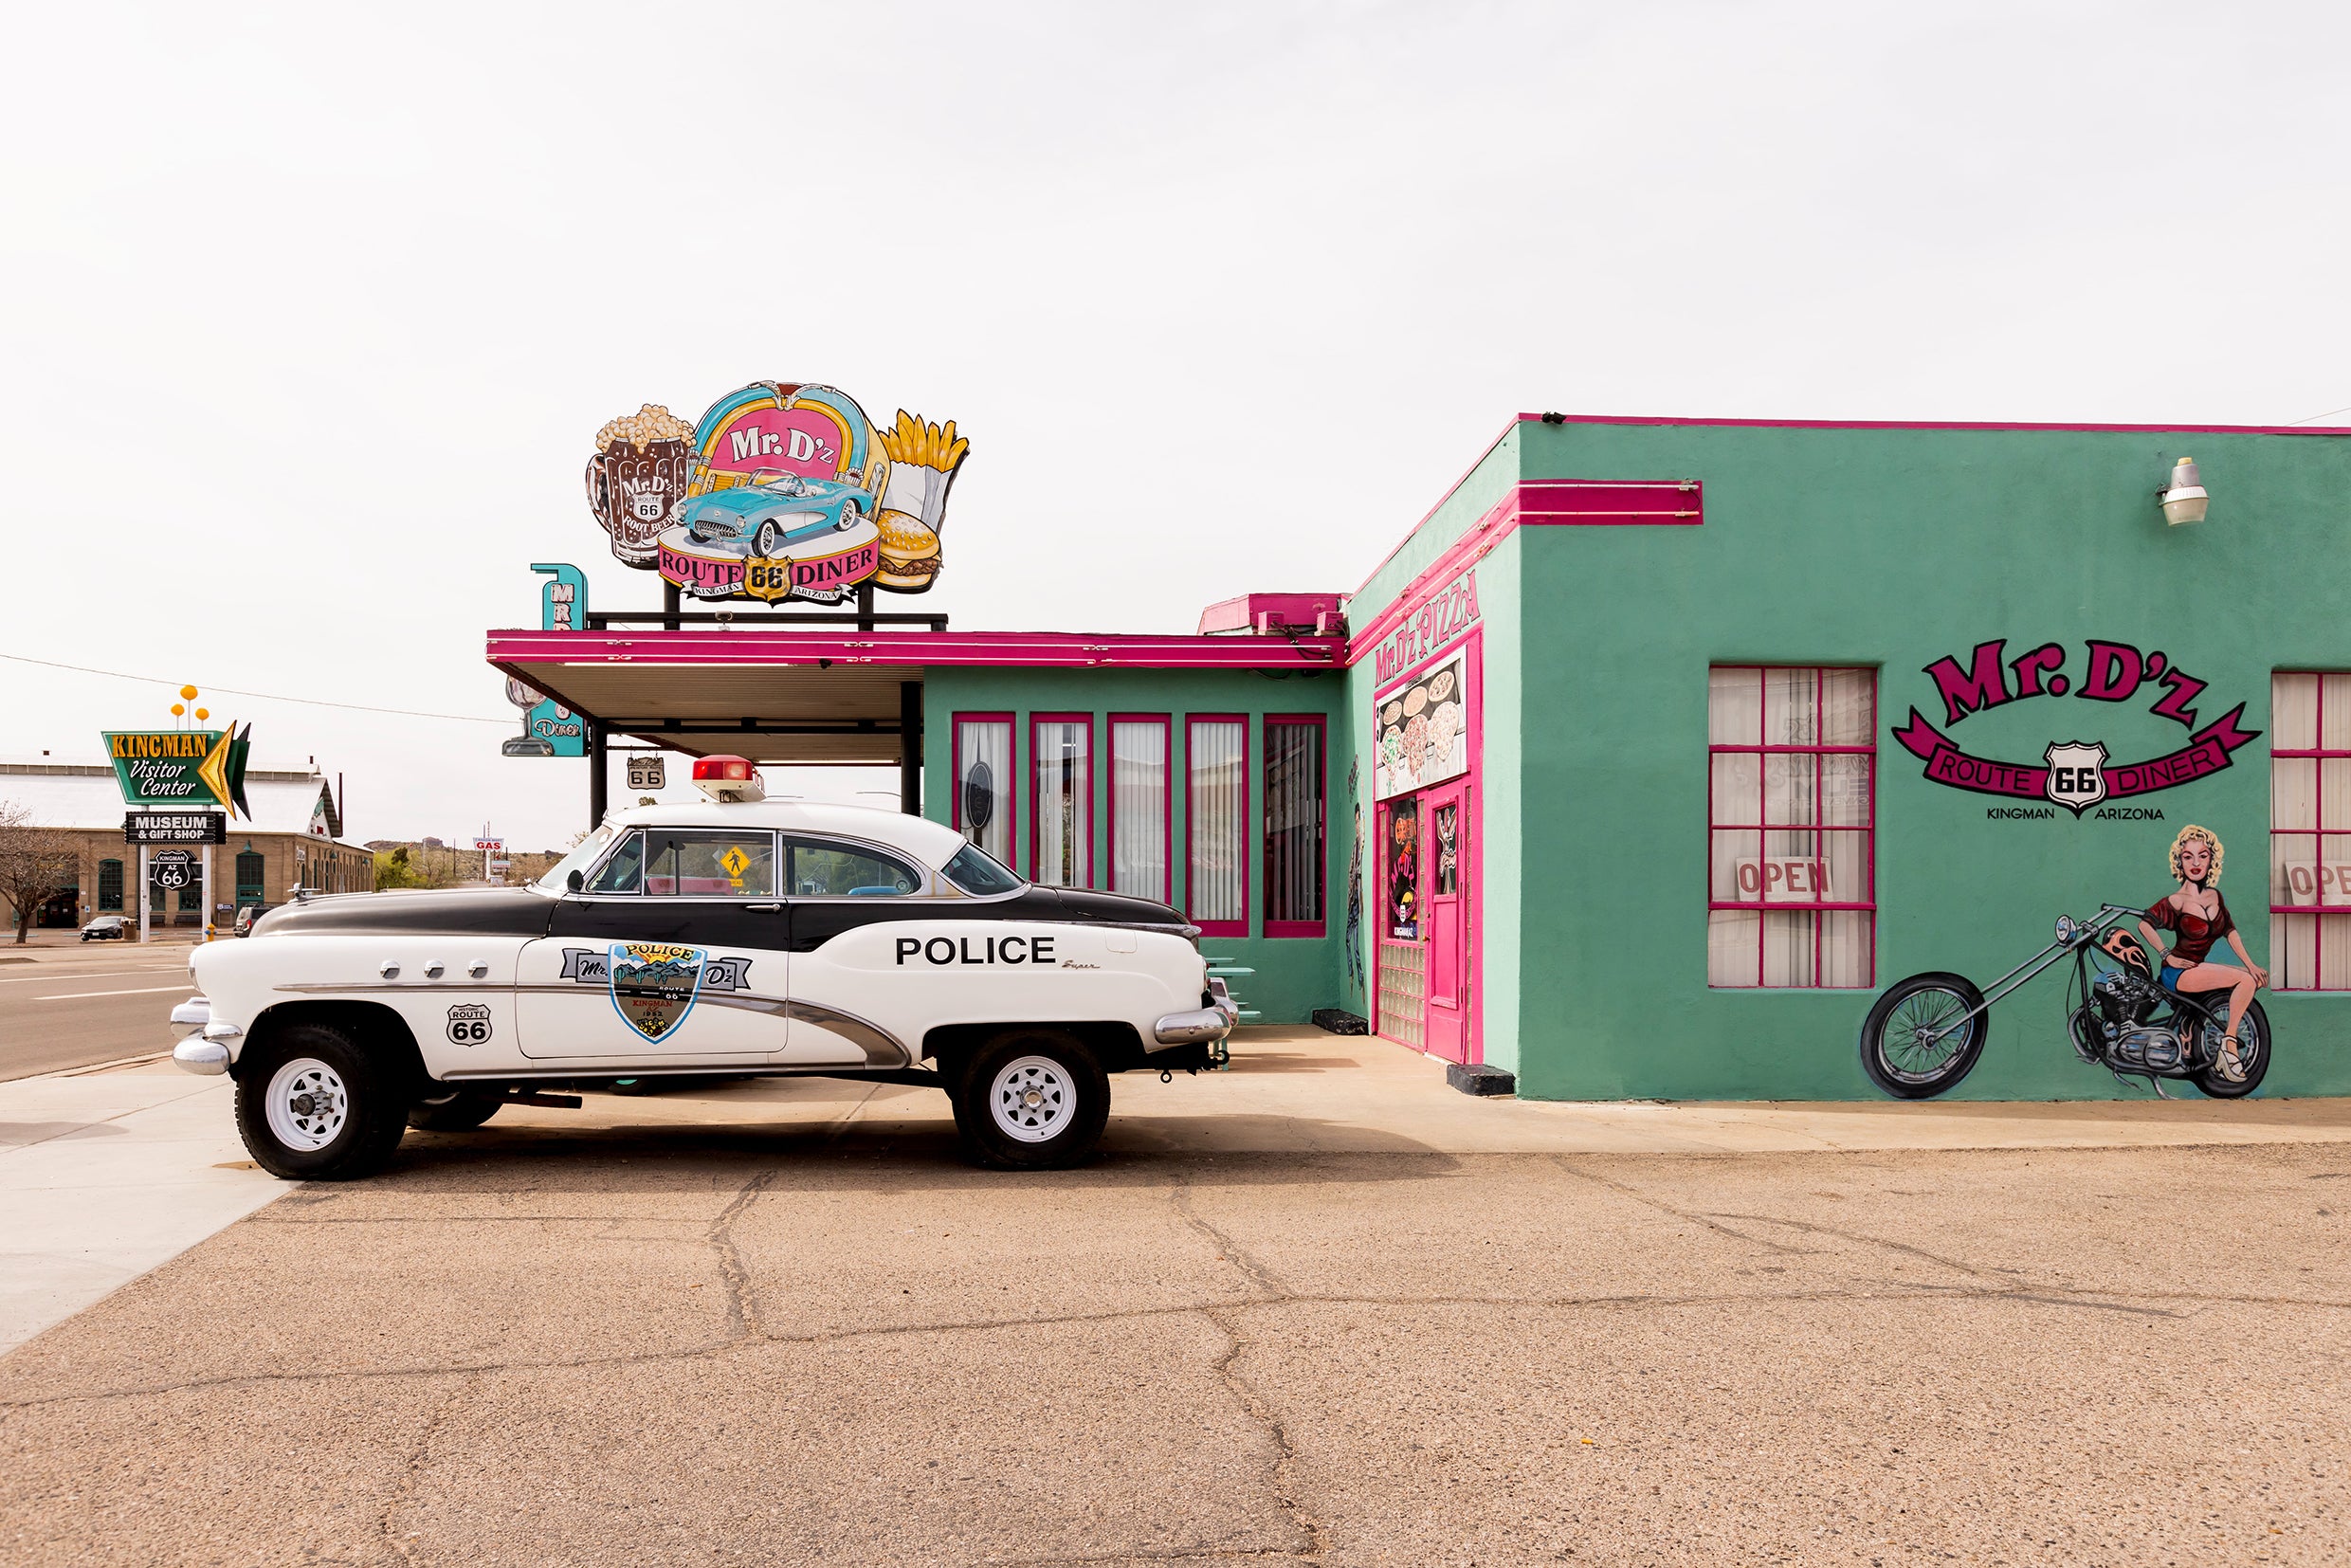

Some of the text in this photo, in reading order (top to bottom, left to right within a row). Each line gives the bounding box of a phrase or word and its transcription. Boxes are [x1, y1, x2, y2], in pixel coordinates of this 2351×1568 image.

[728, 425, 836, 465] Mr. D'z
[640, 504, 658, 516] 66
[624, 514, 675, 533] ROOT BEER
[662, 548, 873, 589] ROUTE 66 DINER
[694, 582, 840, 600] KINGMAN ARIZONA
[1417, 568, 1481, 660] PIZZA
[1921, 638, 2210, 731] Mr. D'z
[111, 734, 208, 757] KINGMAN
[130, 759, 187, 779] Visitor
[630, 771, 661, 785] 66
[1938, 747, 2217, 794] ROUTE 66 DINER
[140, 776, 196, 796] Center
[135, 816, 208, 830] MUSEUM
[1986, 807, 2166, 822] KINGMAN ARIZONA
[137, 830, 205, 840] & GIFT SHOP
[476, 841, 501, 850] GAS
[162, 870, 183, 885] 66
[1738, 863, 1829, 894] OPEN
[626, 944, 695, 962] POLICE
[896, 936, 1057, 966] POLICE
[579, 959, 609, 977] Mr.
[631, 999, 673, 1008] KINGMAN
[452, 1021, 486, 1040] 66
